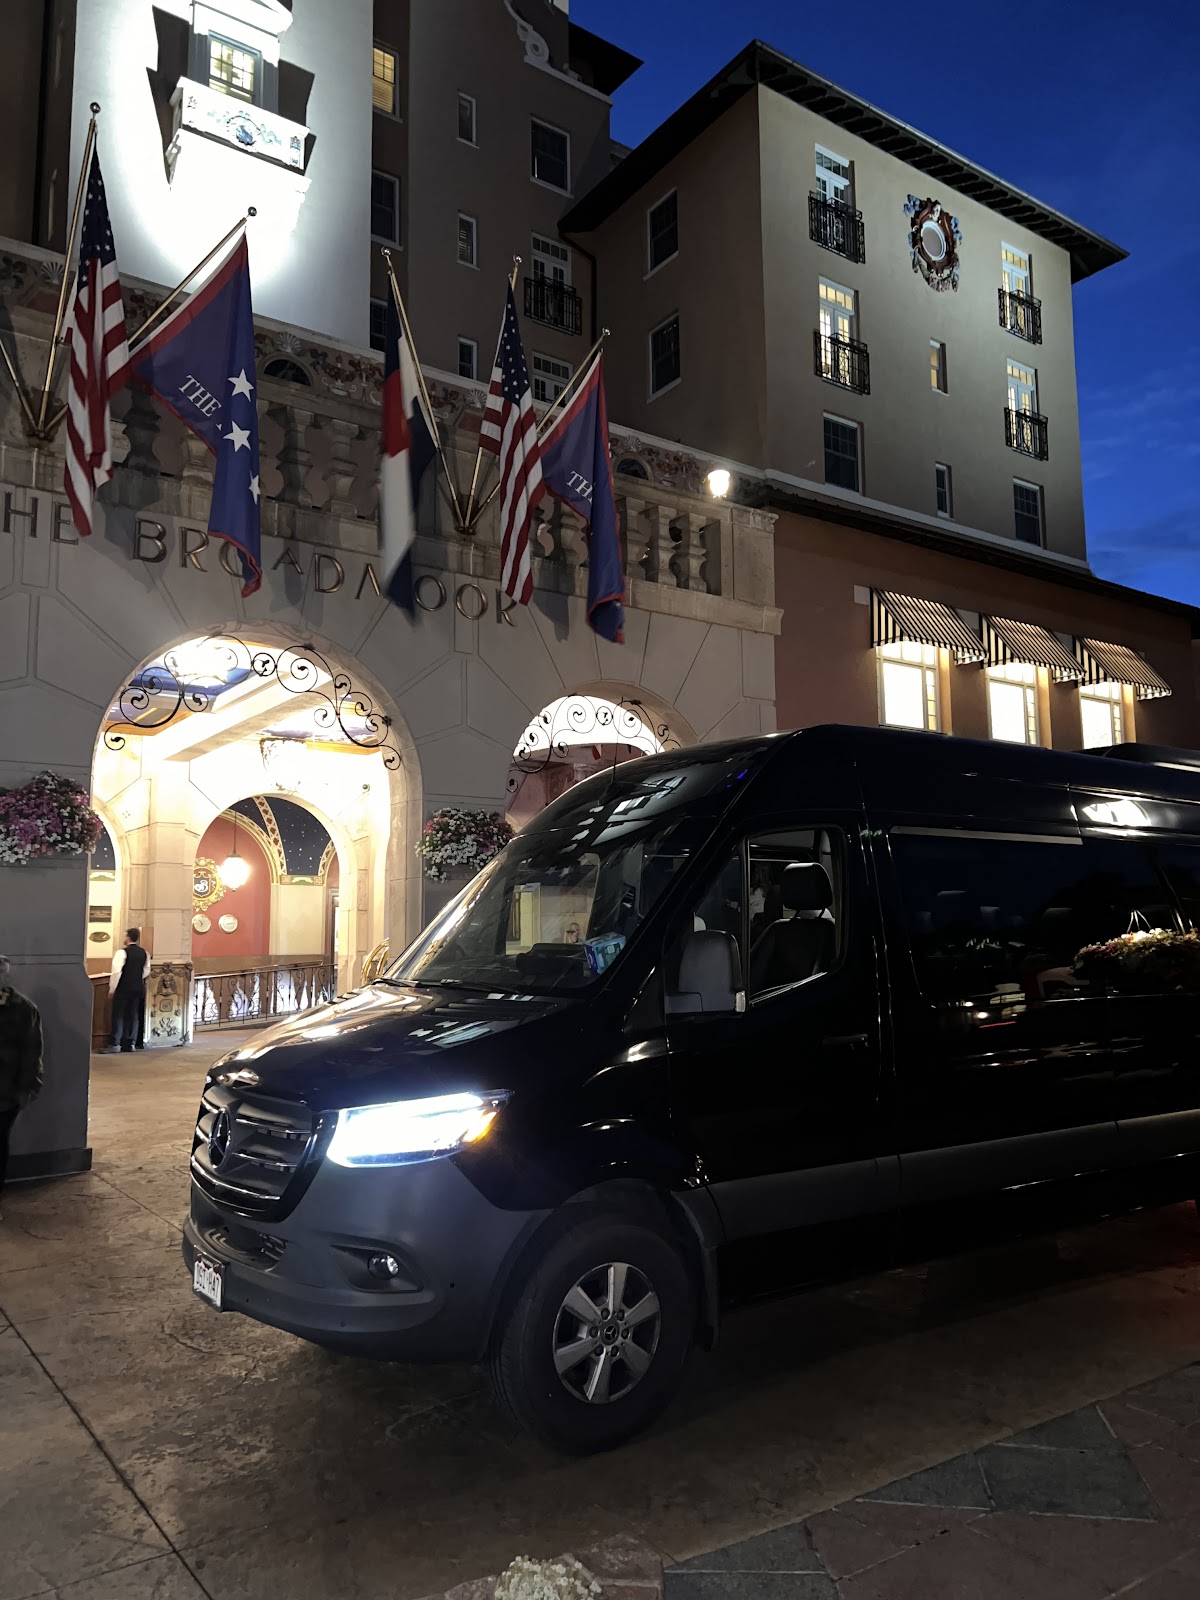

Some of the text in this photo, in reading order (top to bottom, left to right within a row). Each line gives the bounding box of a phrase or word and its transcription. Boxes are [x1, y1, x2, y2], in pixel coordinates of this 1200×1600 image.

[178, 374, 222, 418] THE
[566, 470, 593, 504] TH
[2, 490, 79, 546] HE
